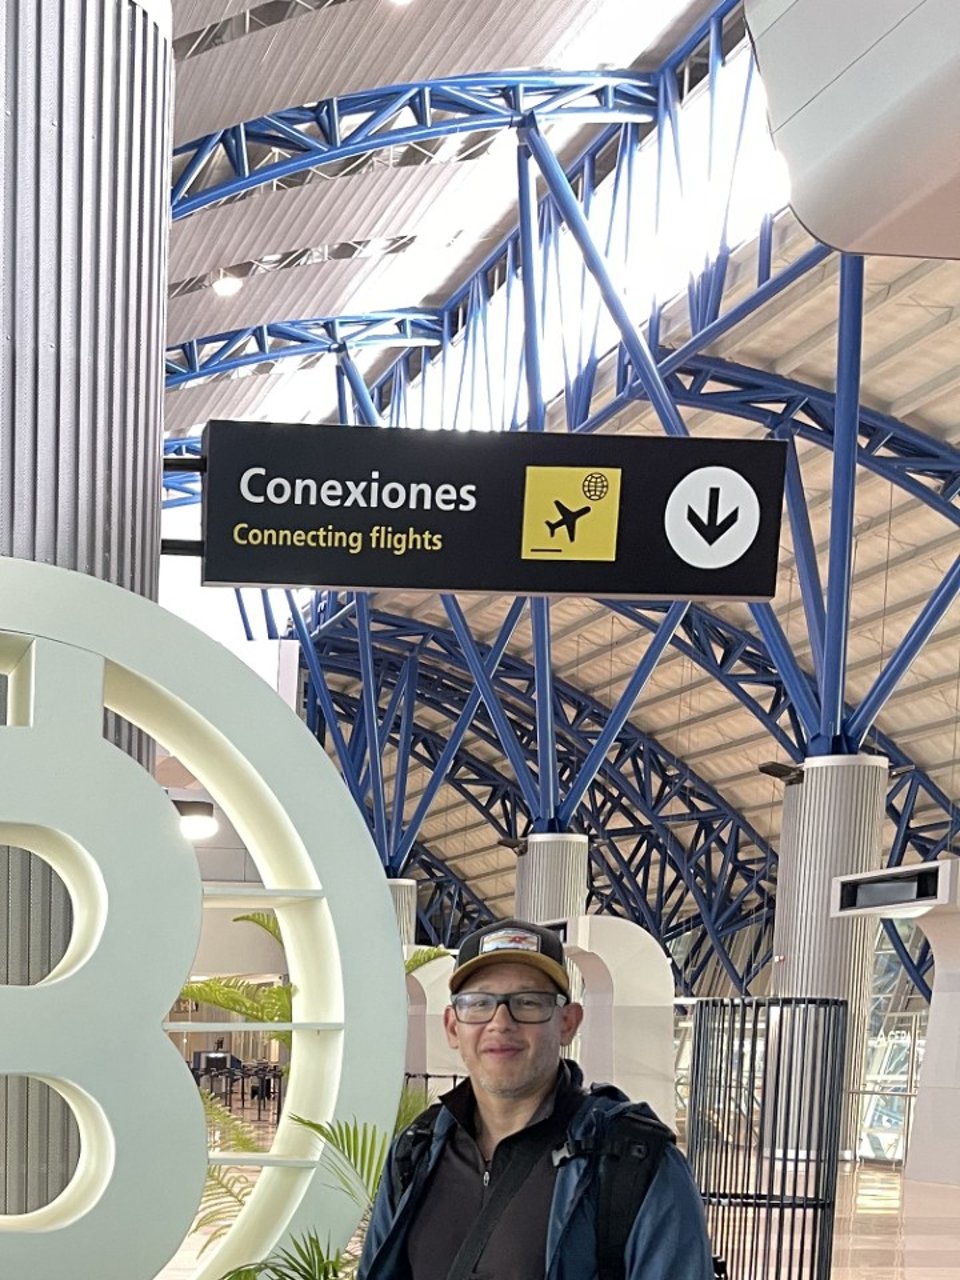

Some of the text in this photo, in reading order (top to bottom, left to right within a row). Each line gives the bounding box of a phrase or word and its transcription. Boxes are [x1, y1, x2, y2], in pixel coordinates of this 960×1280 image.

[239, 466, 477, 512] Conexiones
[232, 522, 443, 555] Connecting flights
